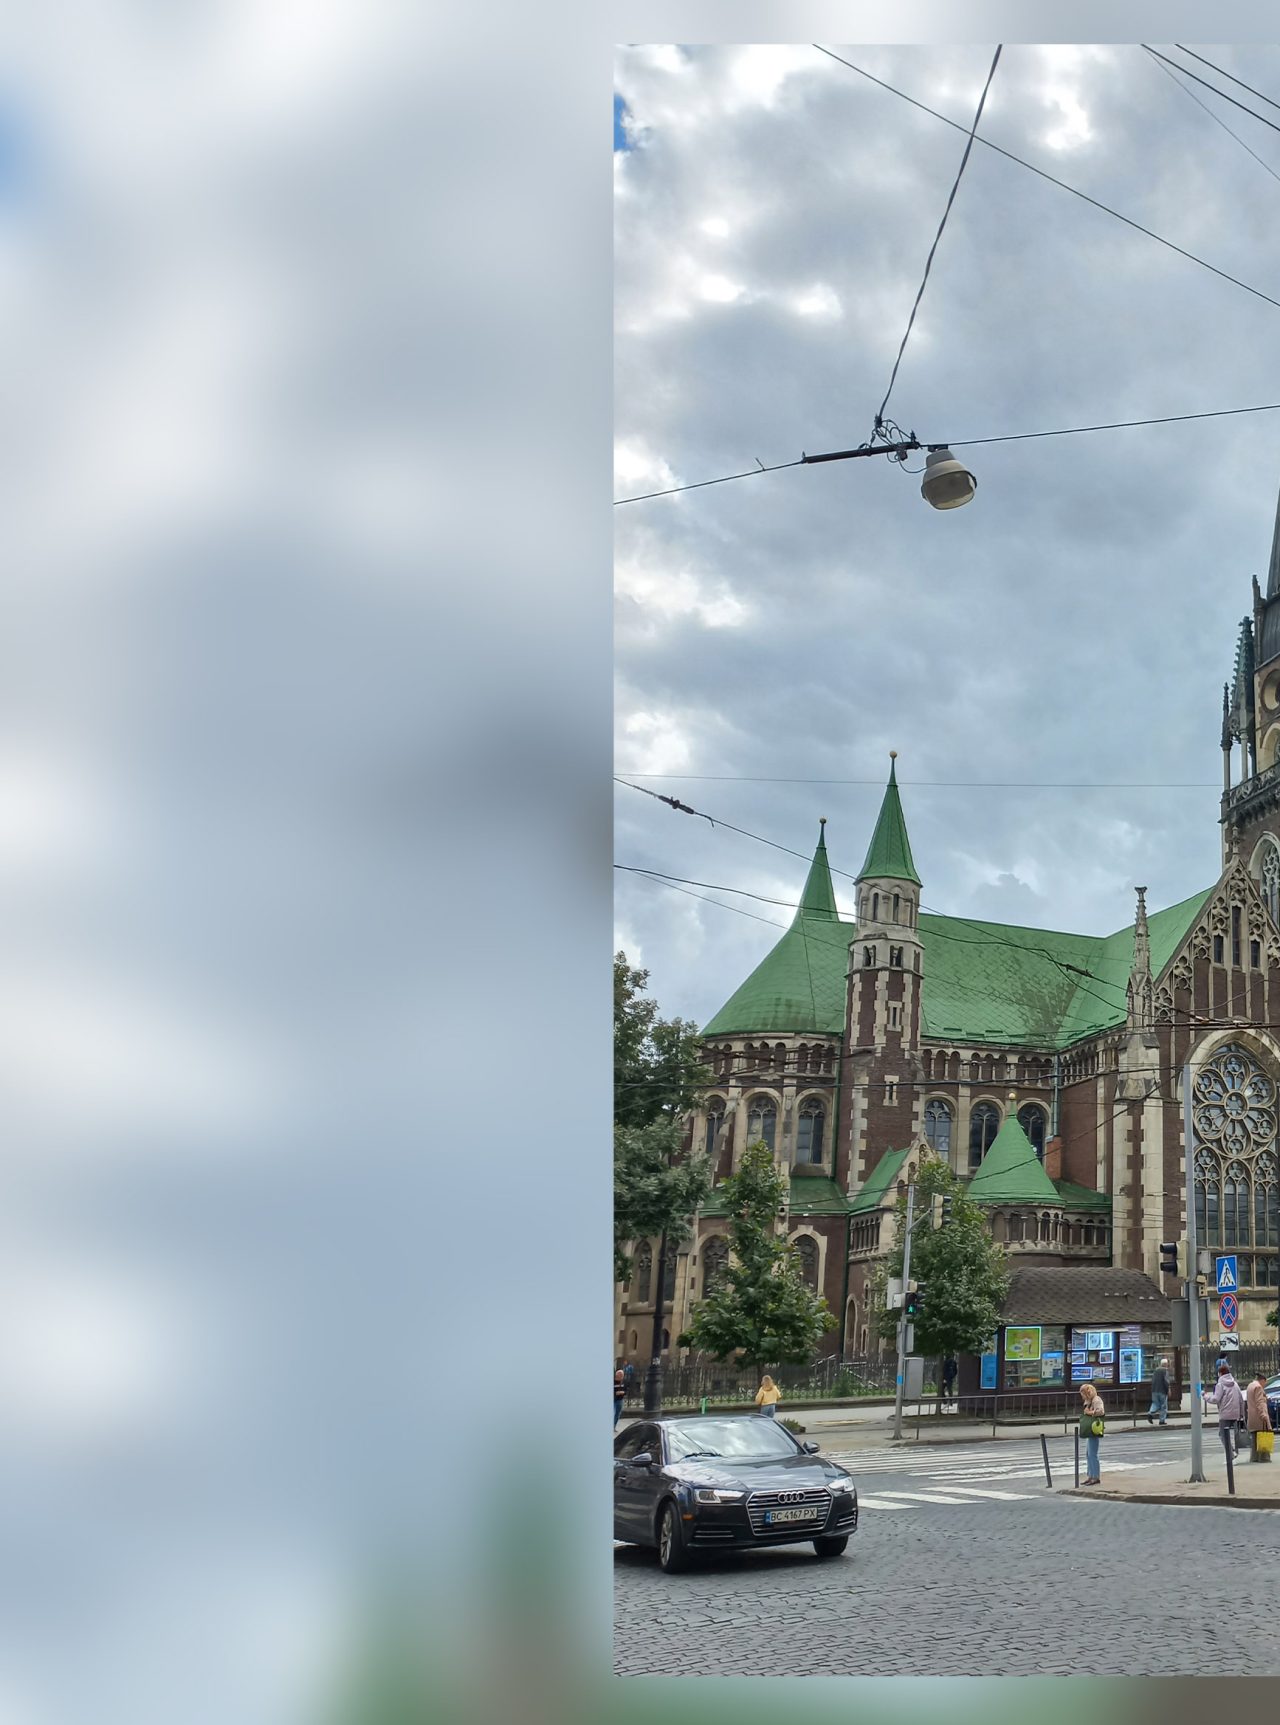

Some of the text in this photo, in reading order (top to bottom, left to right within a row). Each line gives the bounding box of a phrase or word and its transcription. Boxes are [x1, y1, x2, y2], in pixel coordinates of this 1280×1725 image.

[771, 1509, 816, 1521] BC 4167 PX
